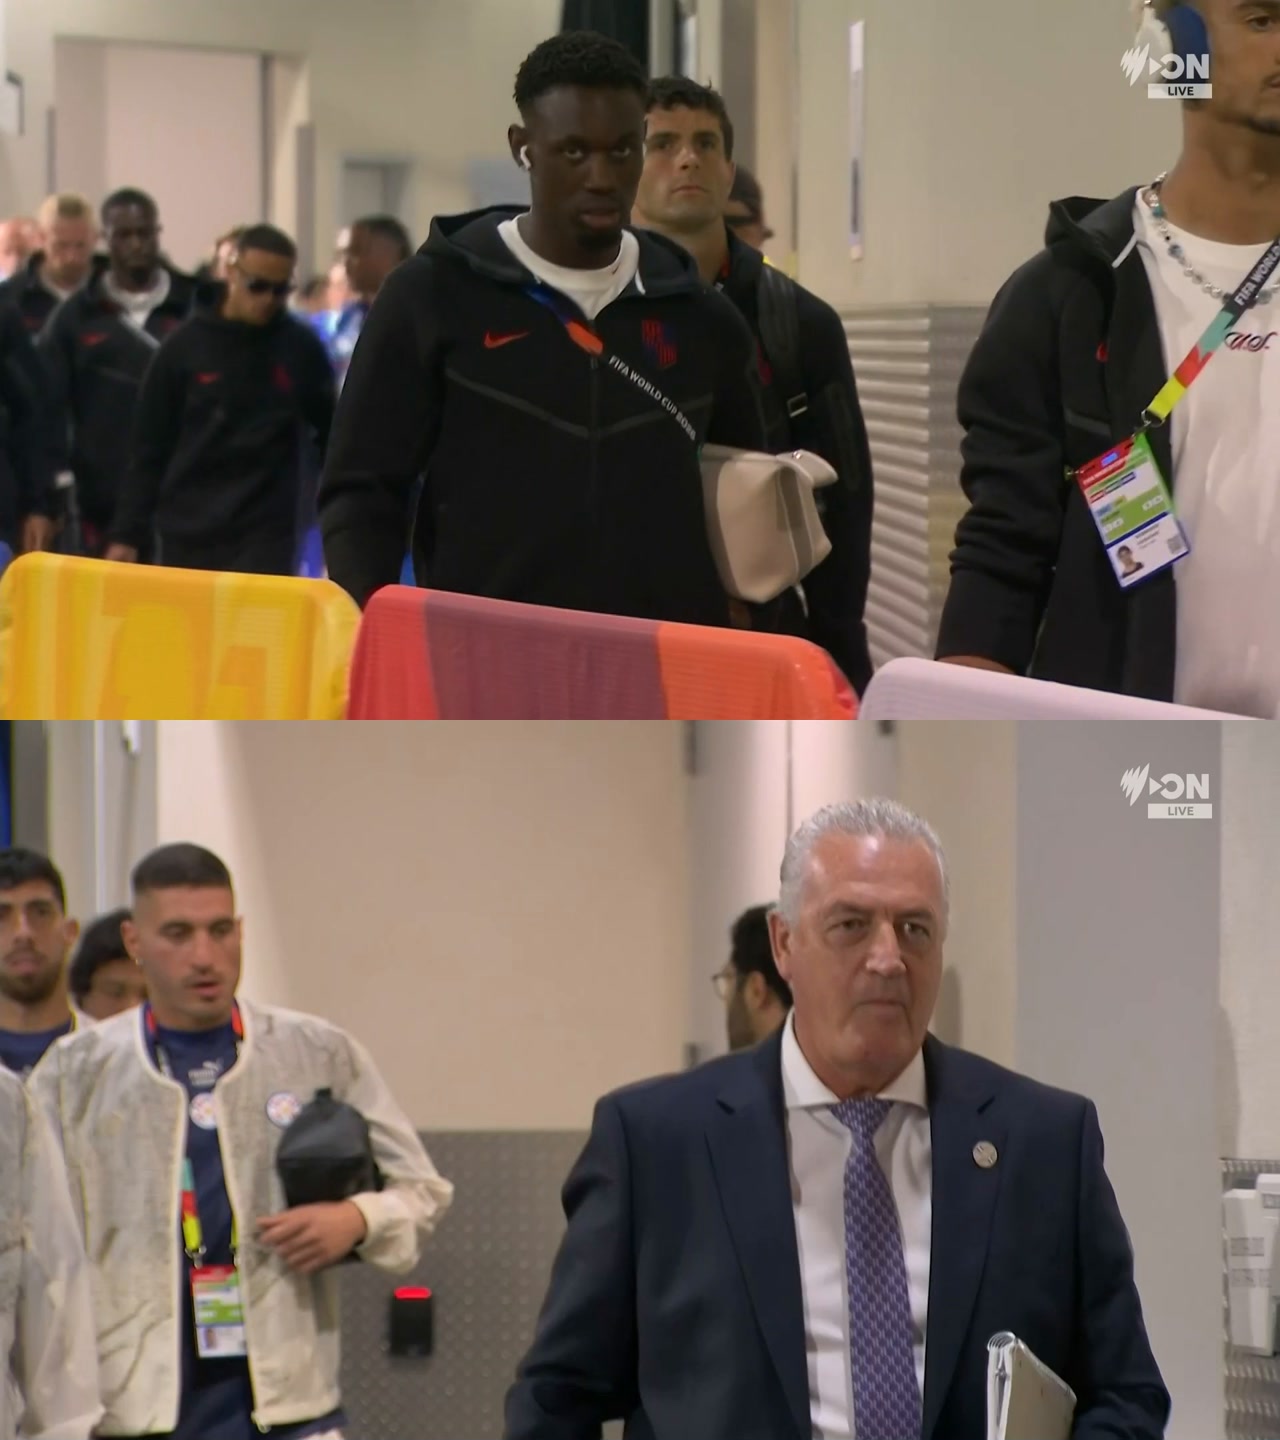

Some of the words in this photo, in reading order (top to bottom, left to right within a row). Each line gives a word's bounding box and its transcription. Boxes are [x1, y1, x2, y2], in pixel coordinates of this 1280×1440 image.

[608, 355, 630, 377] FIFA
[630, 370, 662, 401] WORLD
[661, 396, 678, 415] CUP
